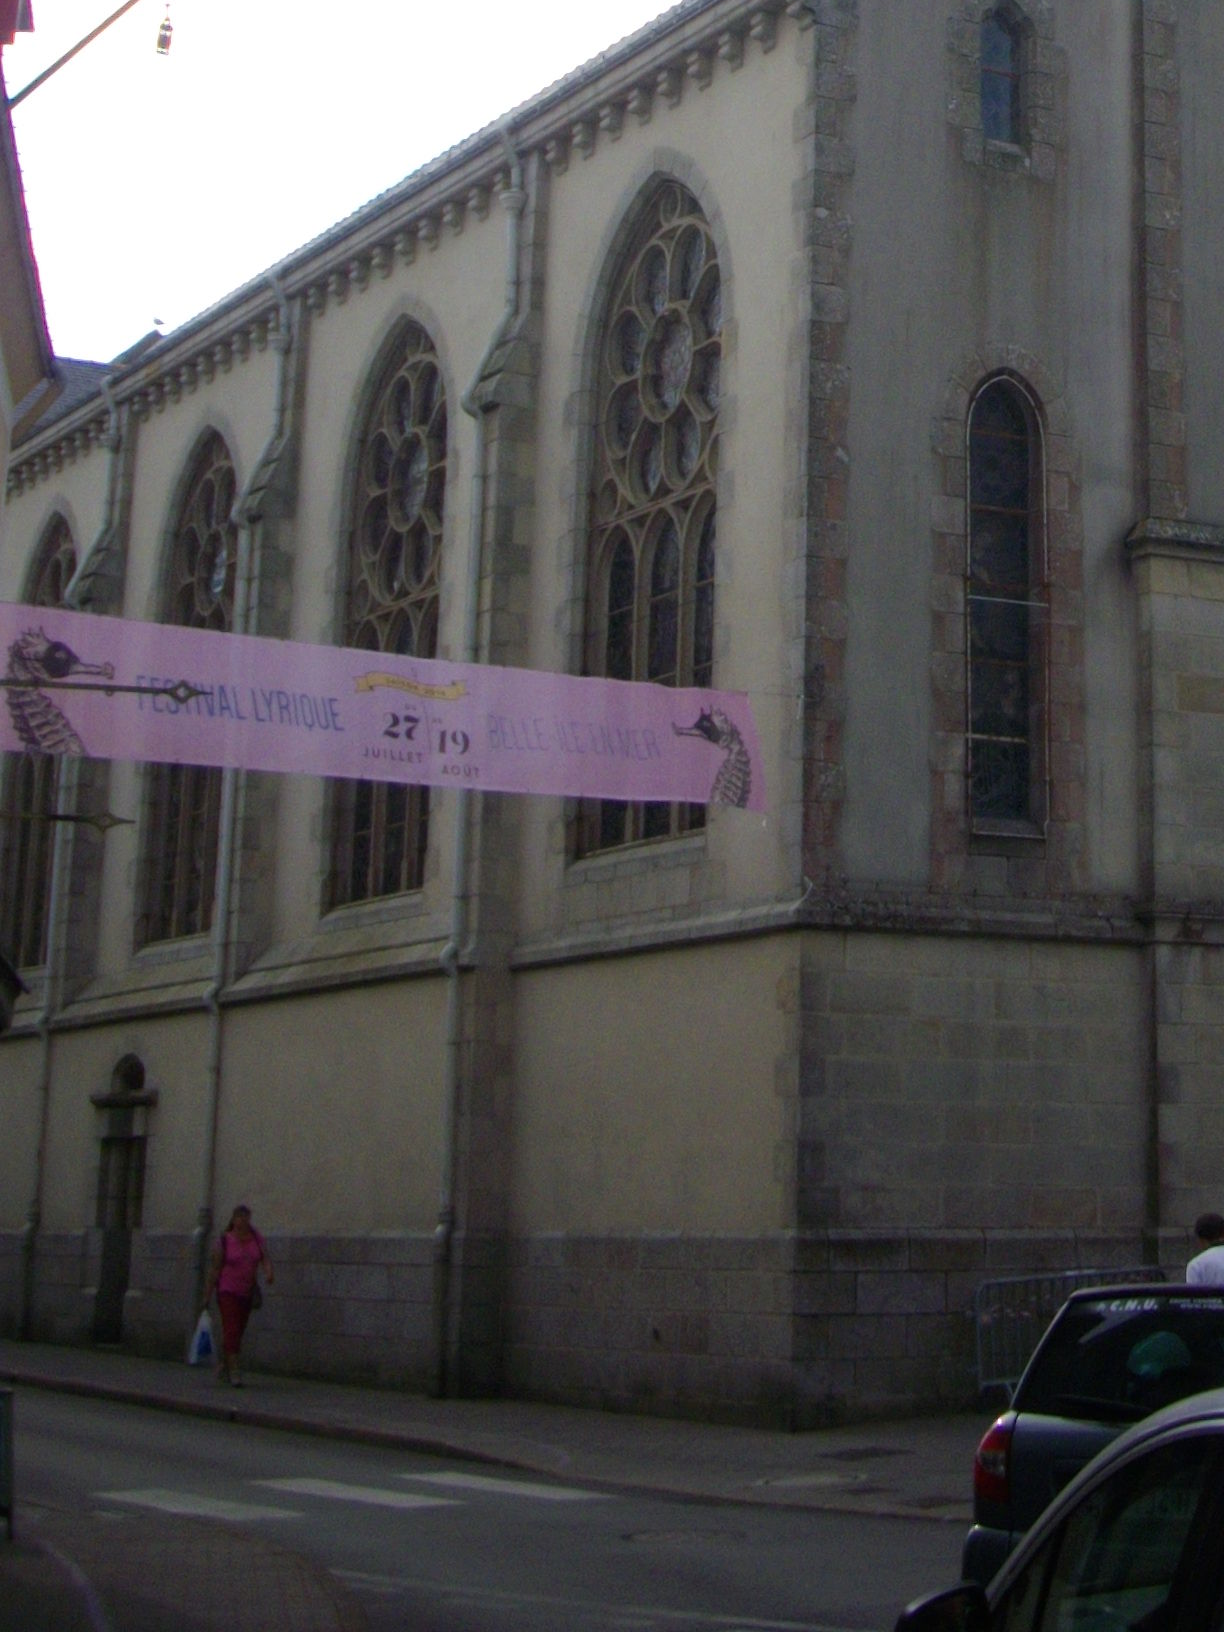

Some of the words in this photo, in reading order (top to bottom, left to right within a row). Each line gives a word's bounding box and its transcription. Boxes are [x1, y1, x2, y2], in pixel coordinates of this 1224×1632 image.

[250, 687, 345, 731] LYRIQUE
[383, 713, 420, 741] 27
[487, 712, 551, 753] BELLE
[587, 722, 615, 756] EN
[615, 726, 662, 761] MER
[362, 747, 423, 764] JUILLET
[439, 730, 470, 756] 19
